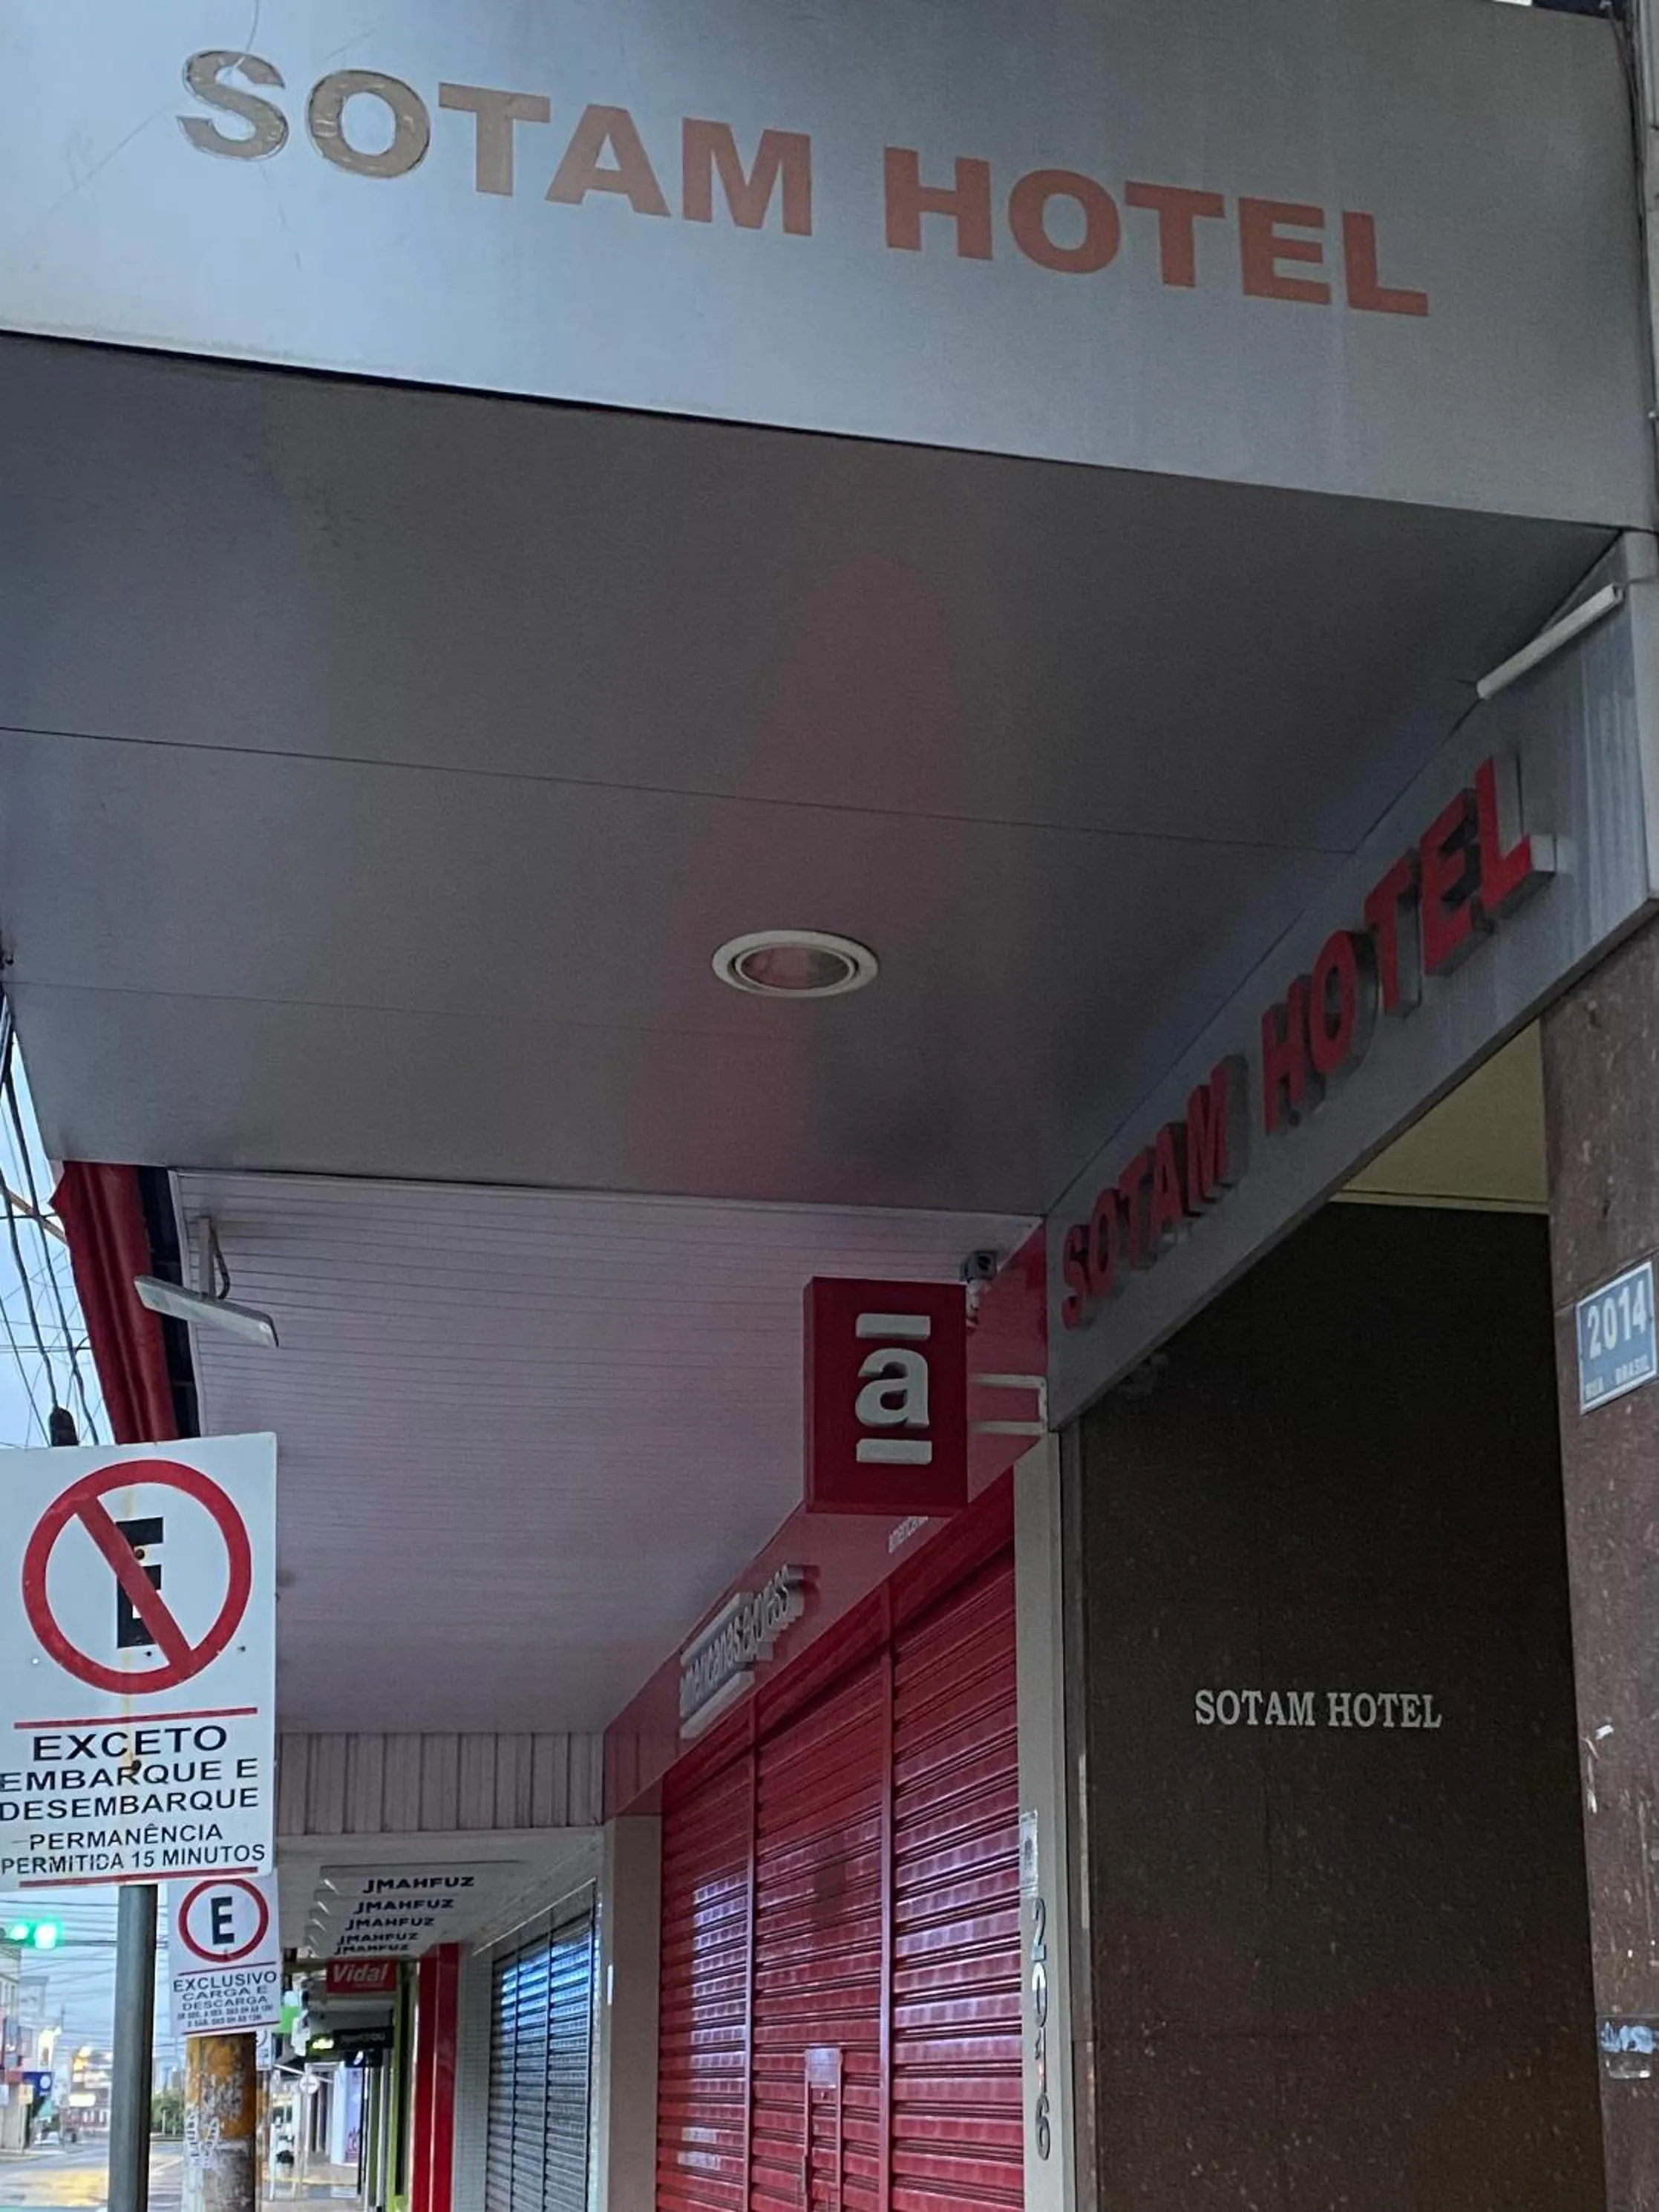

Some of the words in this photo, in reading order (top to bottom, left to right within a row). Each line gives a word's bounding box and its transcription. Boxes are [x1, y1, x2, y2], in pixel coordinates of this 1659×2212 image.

[175, 49, 812, 237] SOTAM
[883, 146, 1429, 317] HOTEL
[1061, 1058, 1235, 1331] SOTAM
[1261, 753, 1538, 1133] HOTEL
[1587, 1279, 1648, 1361] 2014
[855, 1347, 930, 1428] a
[1194, 1689, 1316, 1727] SOTAM
[1326, 1691, 1443, 1729] HOTEL
[33, 1724, 228, 1761] EXCETO
[0, 1760, 223, 1793] EMBARQUE
[236, 1758, 258, 1779] E
[0, 1787, 259, 1821] DESEMBARQUE
[29, 1823, 223, 1851] PERMANÊNCIA
[1, 1852, 125, 1875] PERMITIDA
[131, 1850, 155, 1868] 15
[162, 1843, 266, 1867] MINUTOS
[362, 1876, 475, 1894] JMAHFUZ
[210, 1896, 235, 1946] E
[353, 1898, 455, 1915] JMAHFUZ
[344, 1917, 436, 1931] JMAHFUZ
[173, 1970, 278, 1993] EXCLUSIVO
[333, 1962, 390, 1983] Vidal
[182, 1986, 251, 2002] CARGA
[256, 1984, 268, 1995] E
[182, 1995, 269, 2012] DESCARGA
